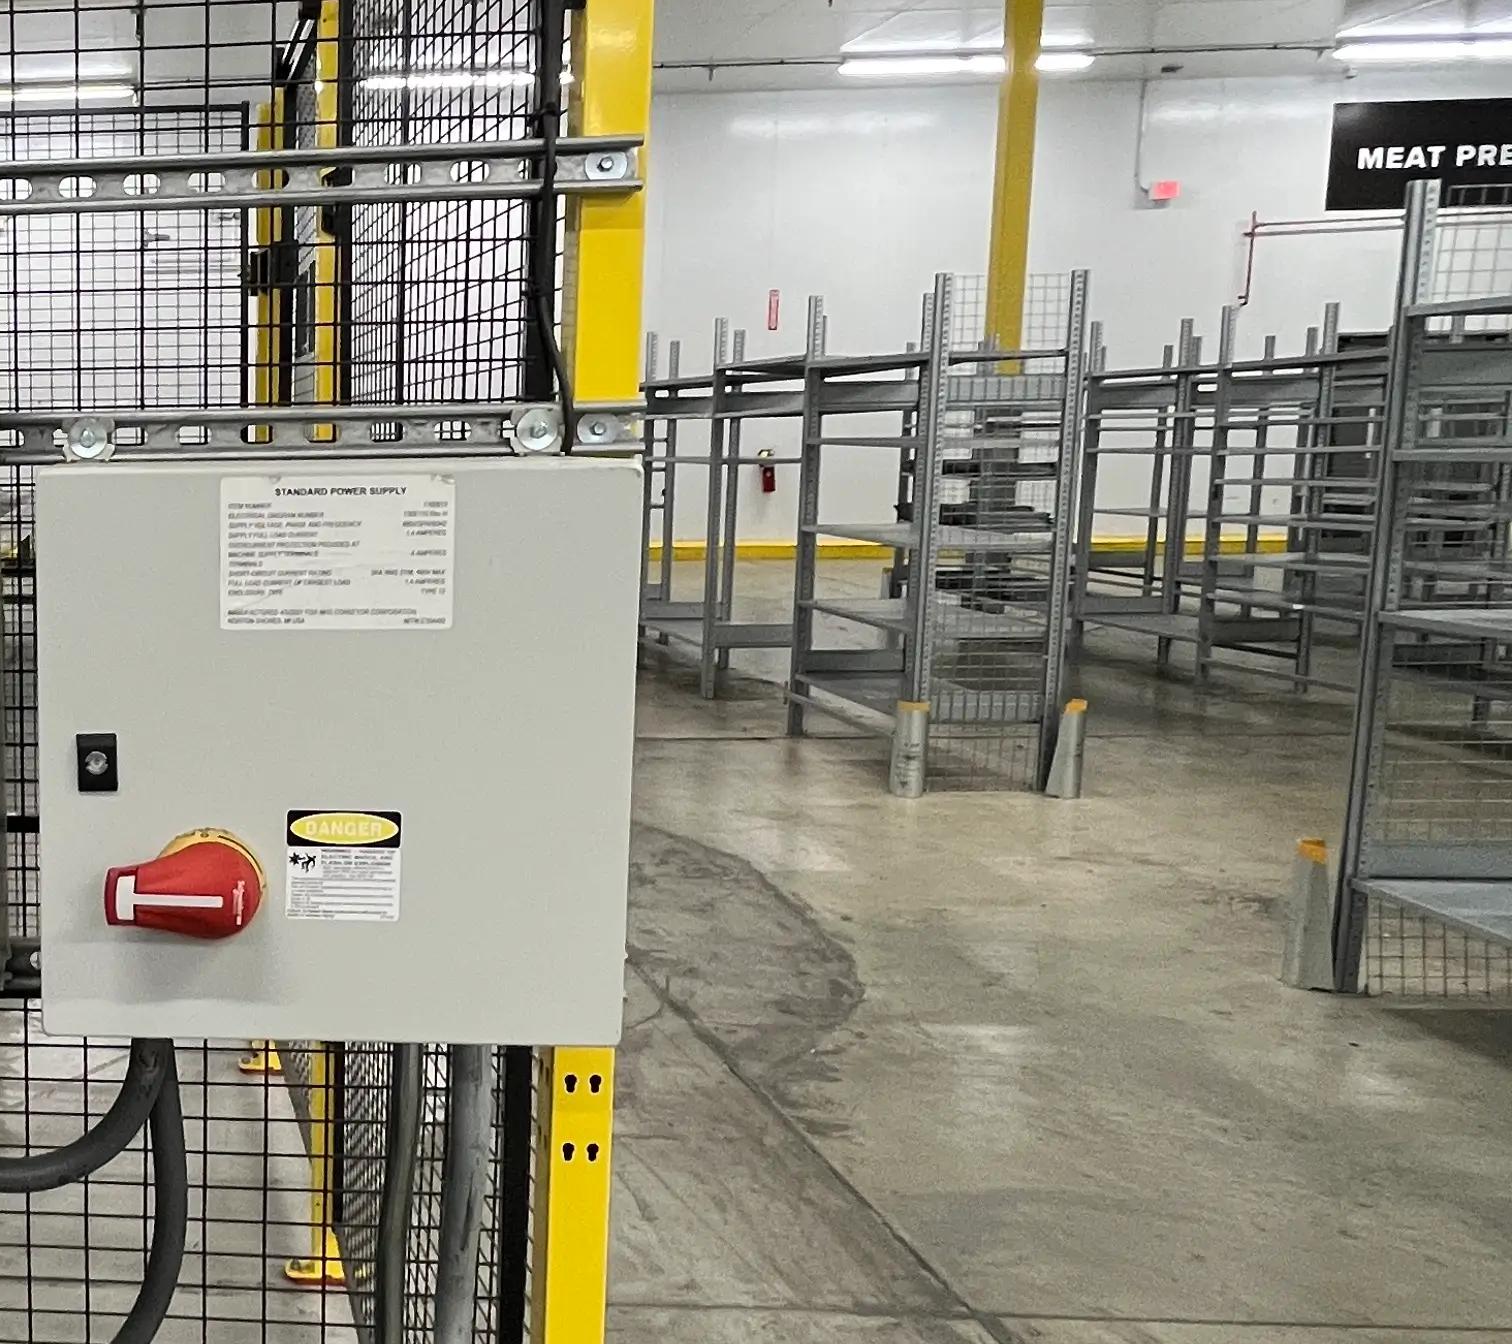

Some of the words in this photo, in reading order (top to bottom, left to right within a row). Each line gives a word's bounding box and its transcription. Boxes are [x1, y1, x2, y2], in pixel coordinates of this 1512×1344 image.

[1357, 146, 1446, 170] MEAT
[1455, 144, 1512, 167] PRE
[274, 487, 328, 496] STANDARD
[330, 487, 367, 496] POWER
[369, 487, 407, 496] SUPPLY
[305, 820, 382, 837] DANGER
